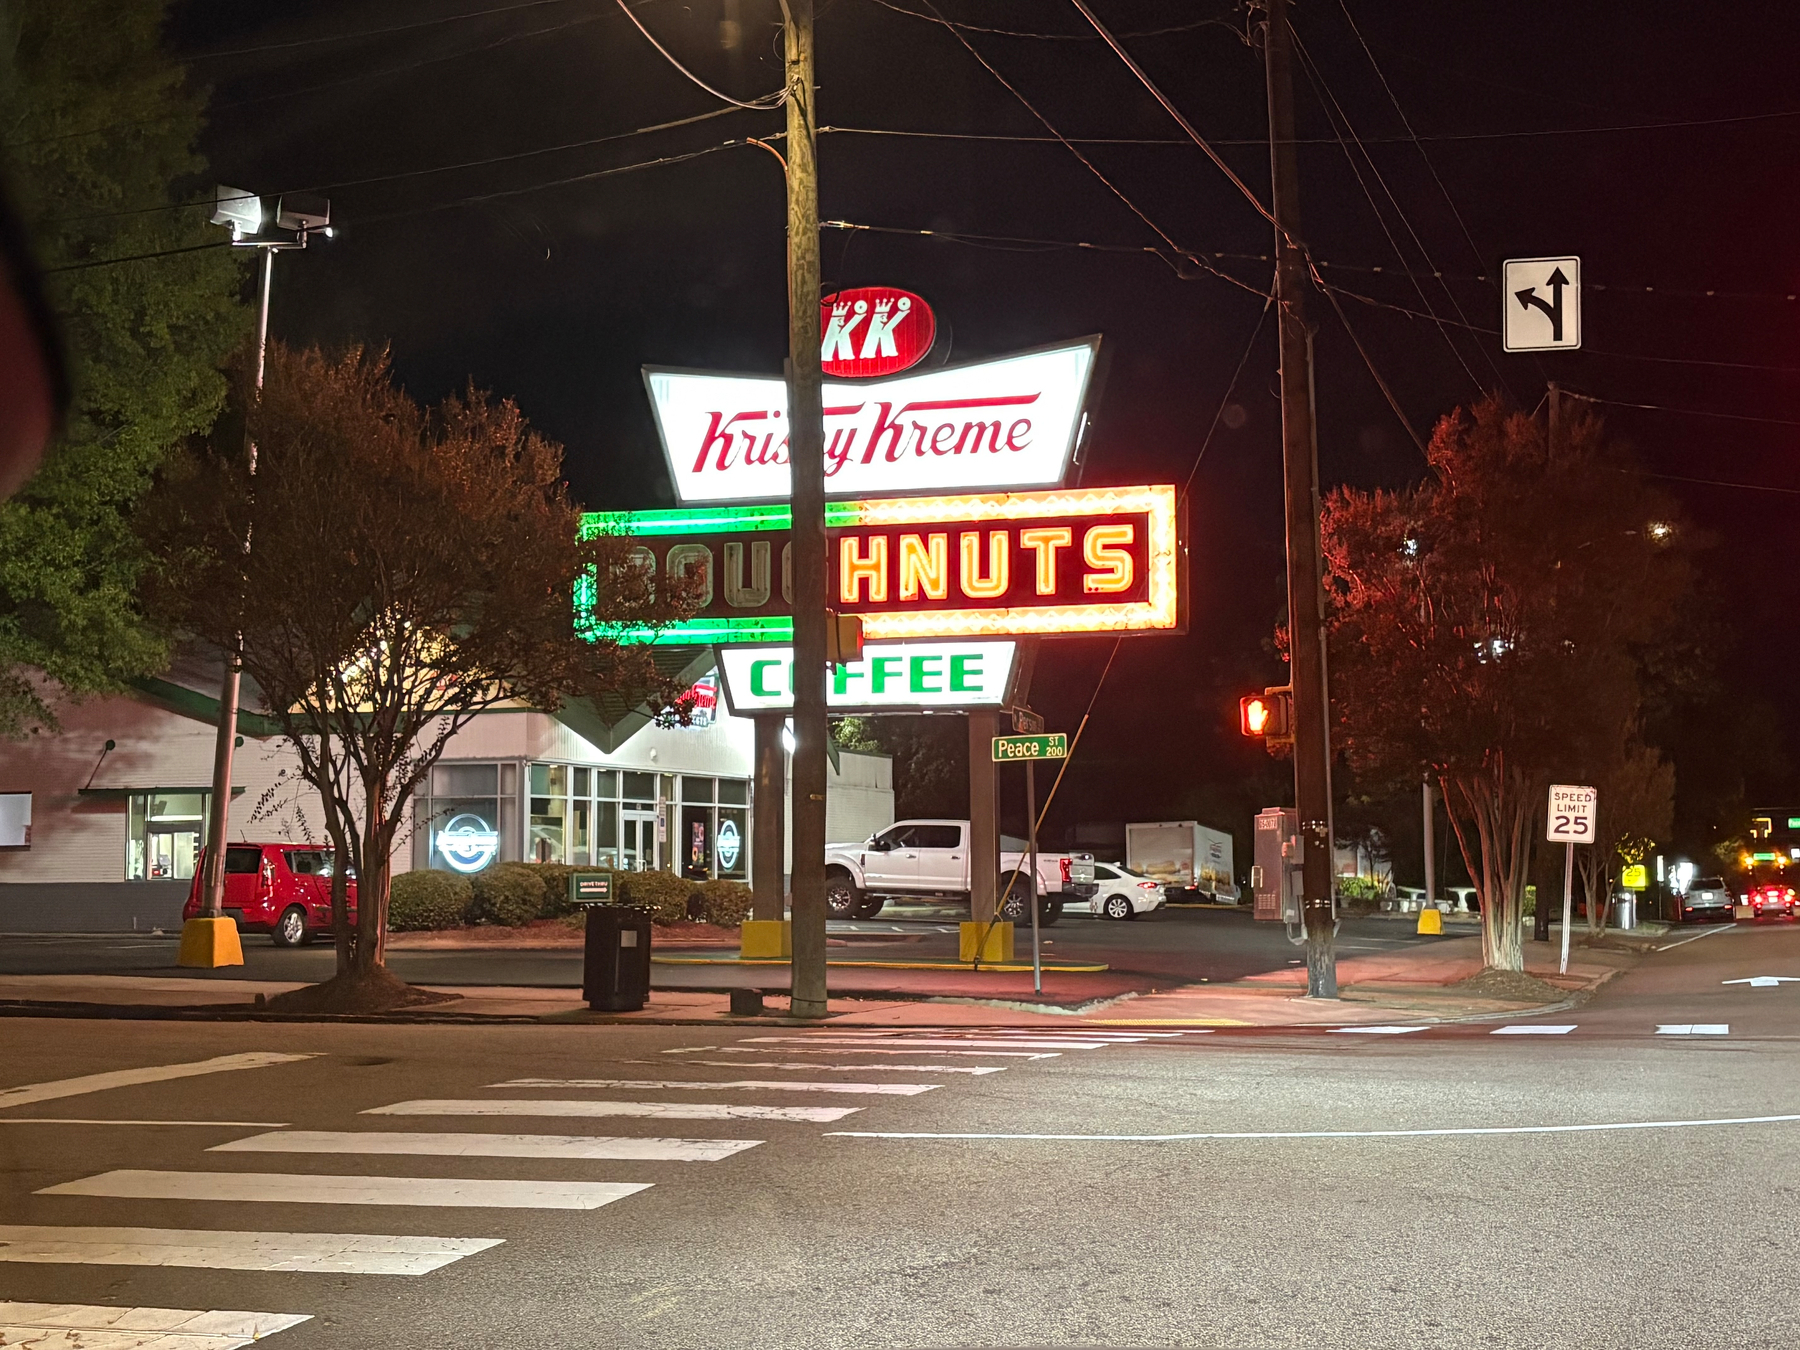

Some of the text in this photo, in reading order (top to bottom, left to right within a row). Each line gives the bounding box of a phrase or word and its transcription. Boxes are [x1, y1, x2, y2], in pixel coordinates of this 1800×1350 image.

[692, 391, 1042, 477] Krisy Kreme
[750, 654, 984, 696] CFFEE
[998, 736, 1059, 757] Peace ST
[1046, 747, 1063, 757] 200
[1554, 792, 1592, 802] SPEED
[1556, 803, 1587, 813] LIMIT
[1553, 815, 1589, 835] 25
